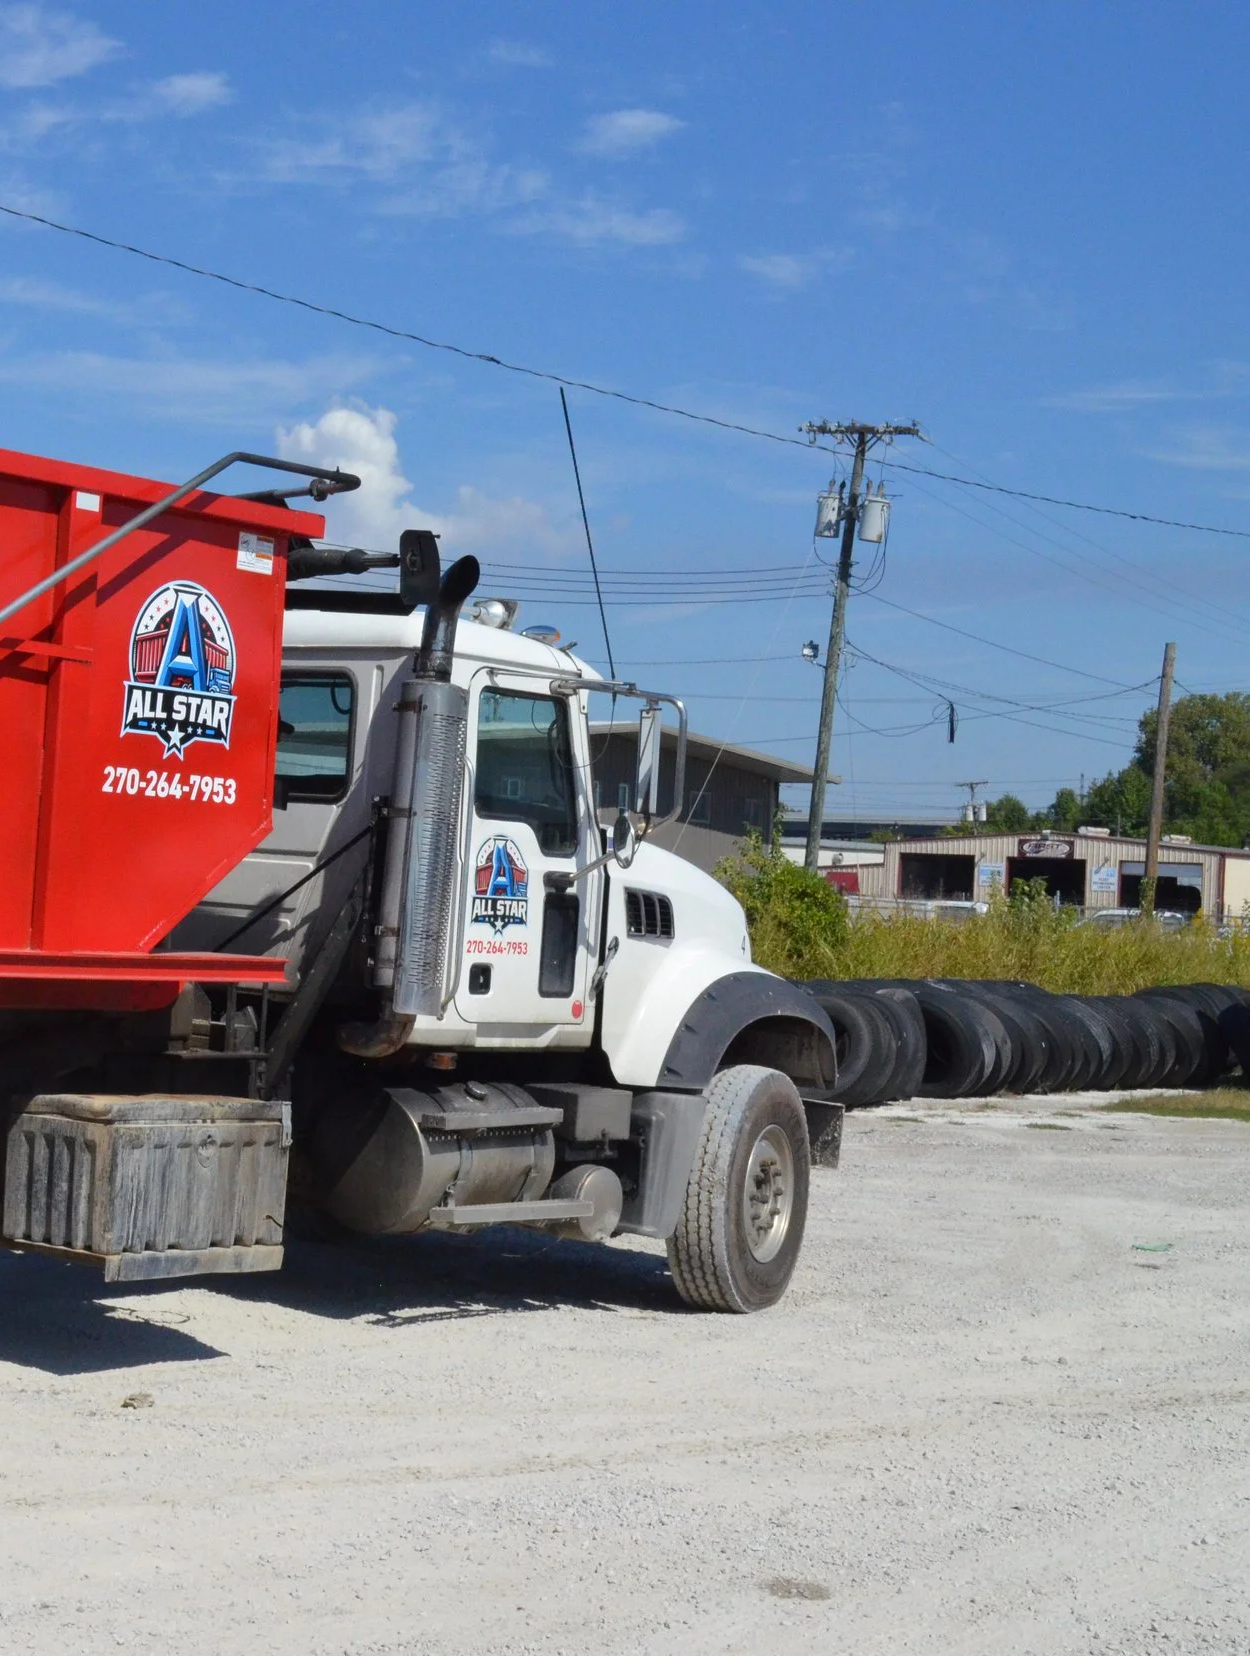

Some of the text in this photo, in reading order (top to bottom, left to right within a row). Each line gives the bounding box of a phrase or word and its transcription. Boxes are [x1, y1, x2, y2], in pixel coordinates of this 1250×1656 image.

[126, 689, 230, 738] ALL STAR
[101, 765, 237, 805] 270-264-7953
[472, 899, 527, 920] ALL STAR
[466, 940, 528, 955] 270-264-7953
